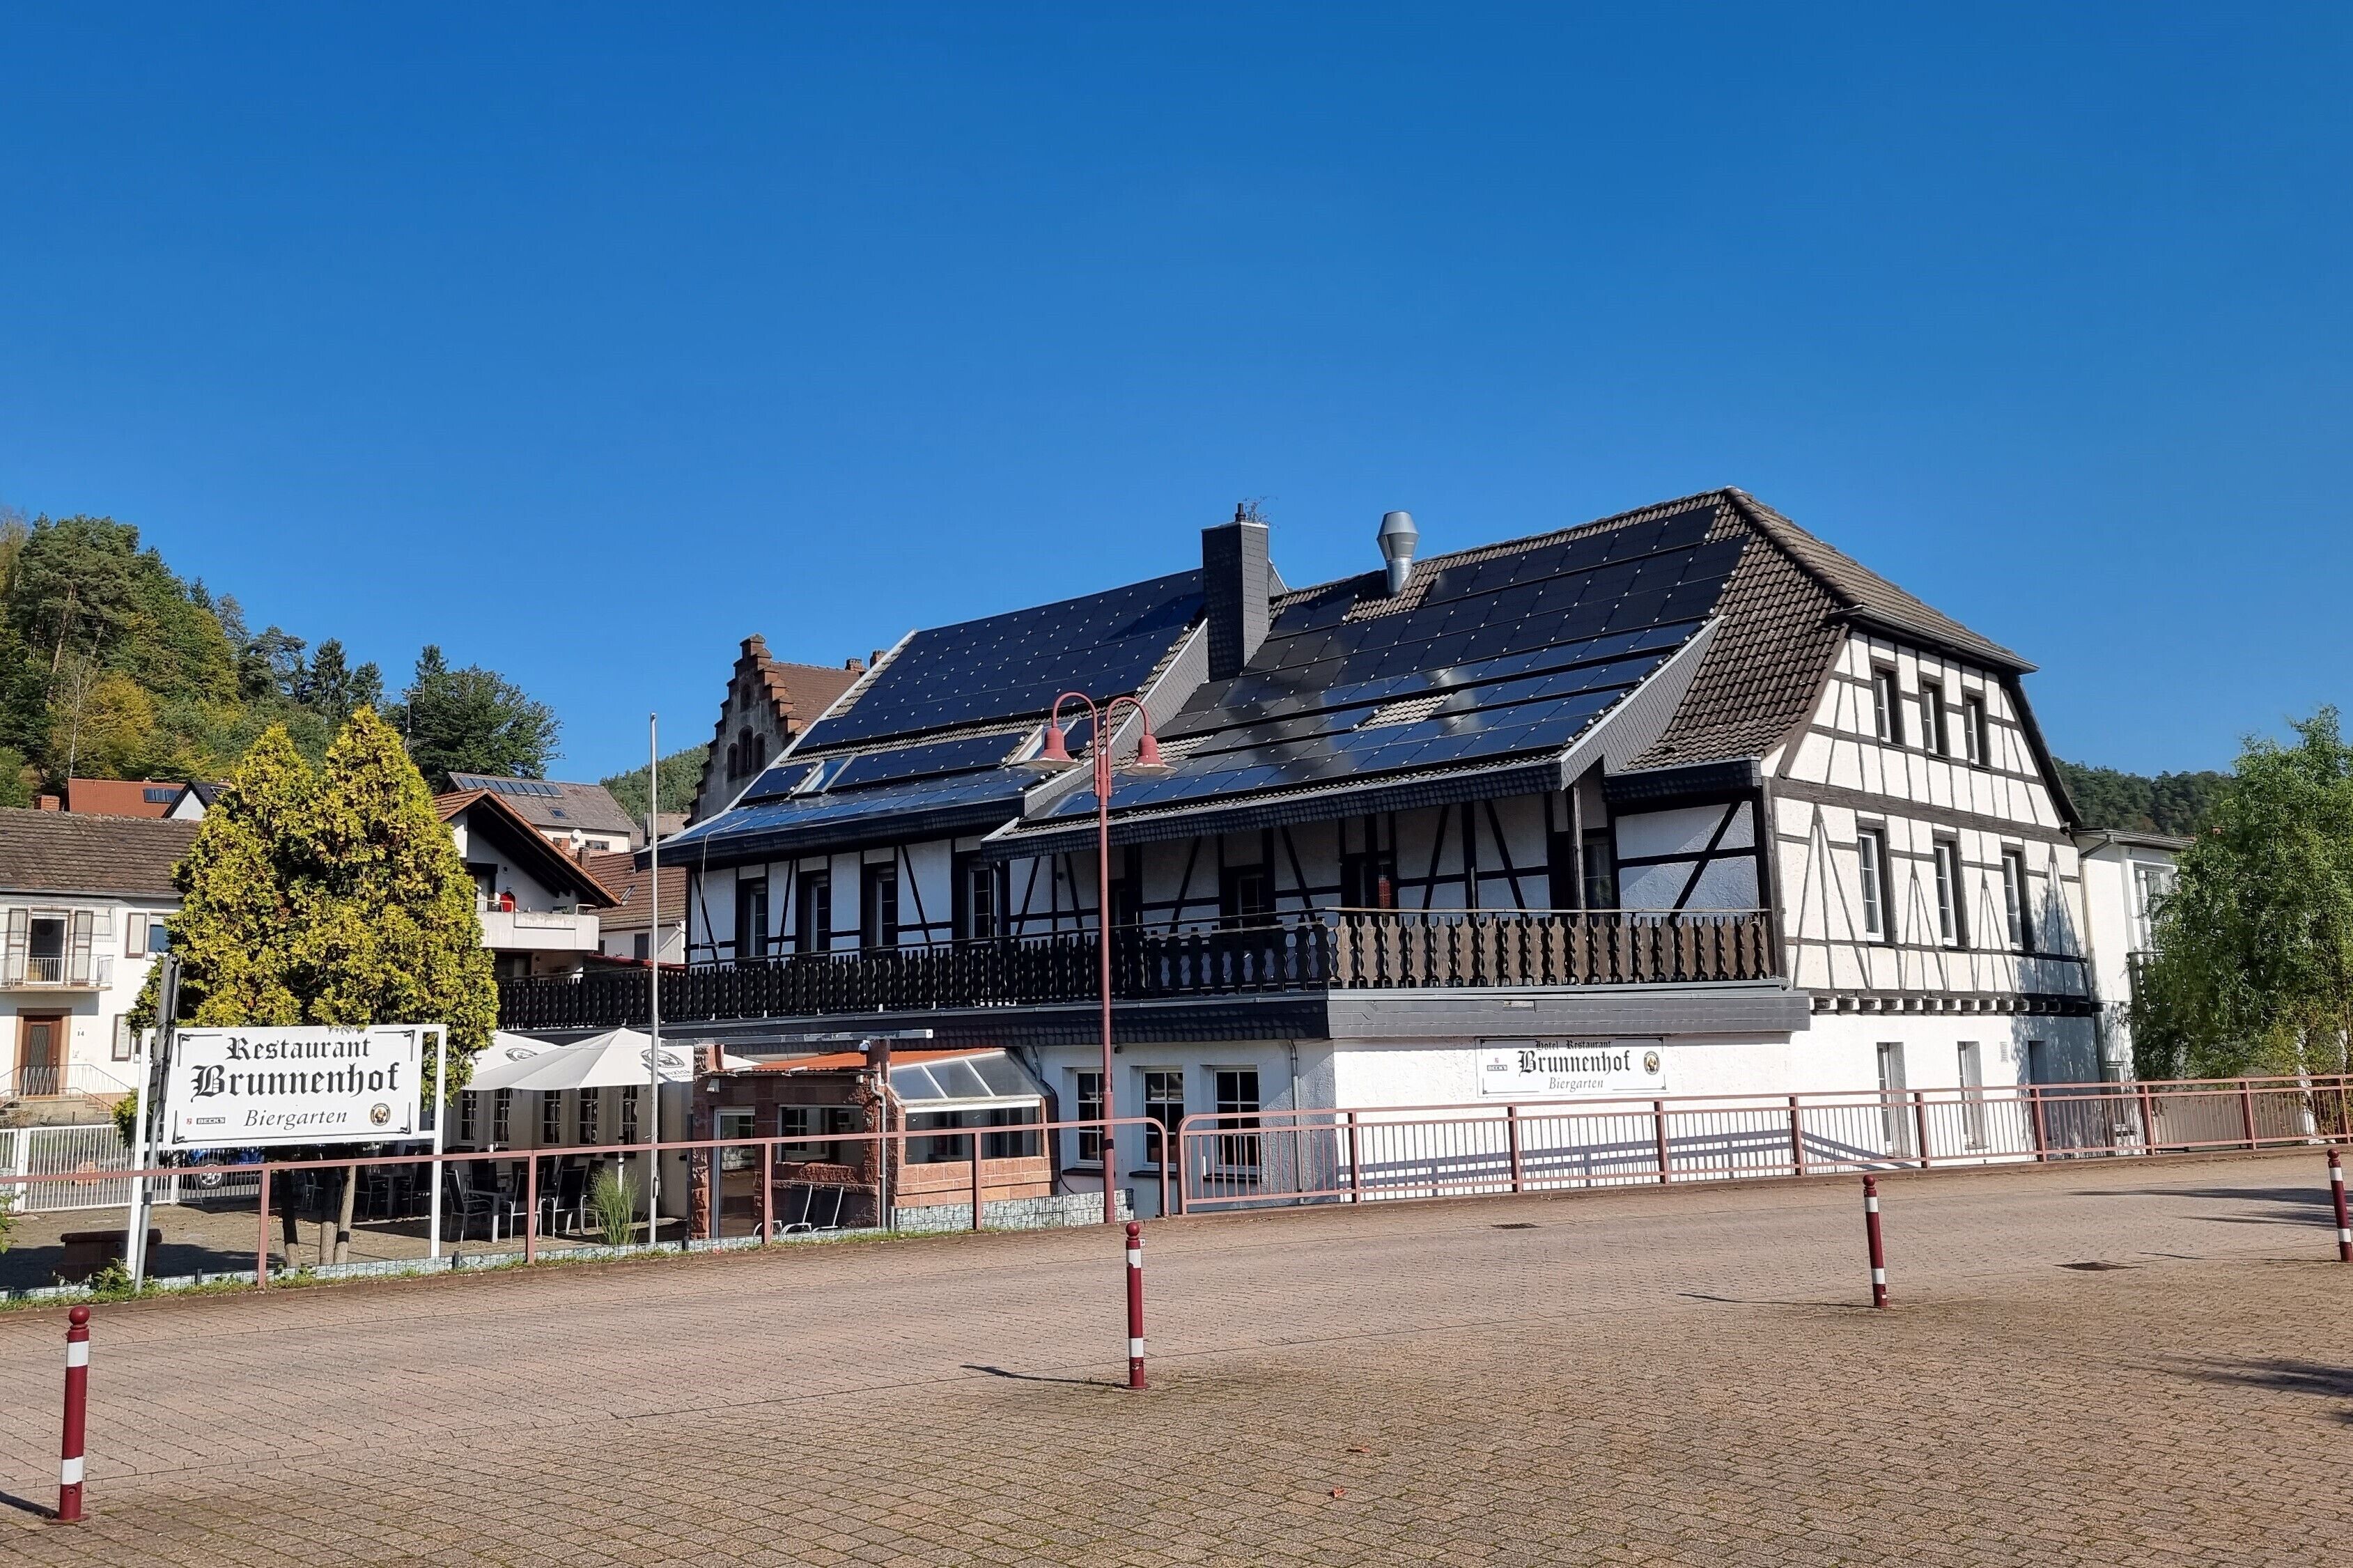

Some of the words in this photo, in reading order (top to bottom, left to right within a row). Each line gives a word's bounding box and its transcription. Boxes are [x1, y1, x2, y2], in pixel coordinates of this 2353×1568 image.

[225, 1037, 371, 1061] Restaurant
[1535, 1040, 1559, 1050] Hotel
[1566, 1039, 1611, 1050] Restaurant
[1517, 1050, 1631, 1077] Brunnenhof
[190, 1062, 401, 1103] Brunnenhof
[1549, 1076, 1603, 1092] Biergarten
[243, 1109, 348, 1131] Biergarten
